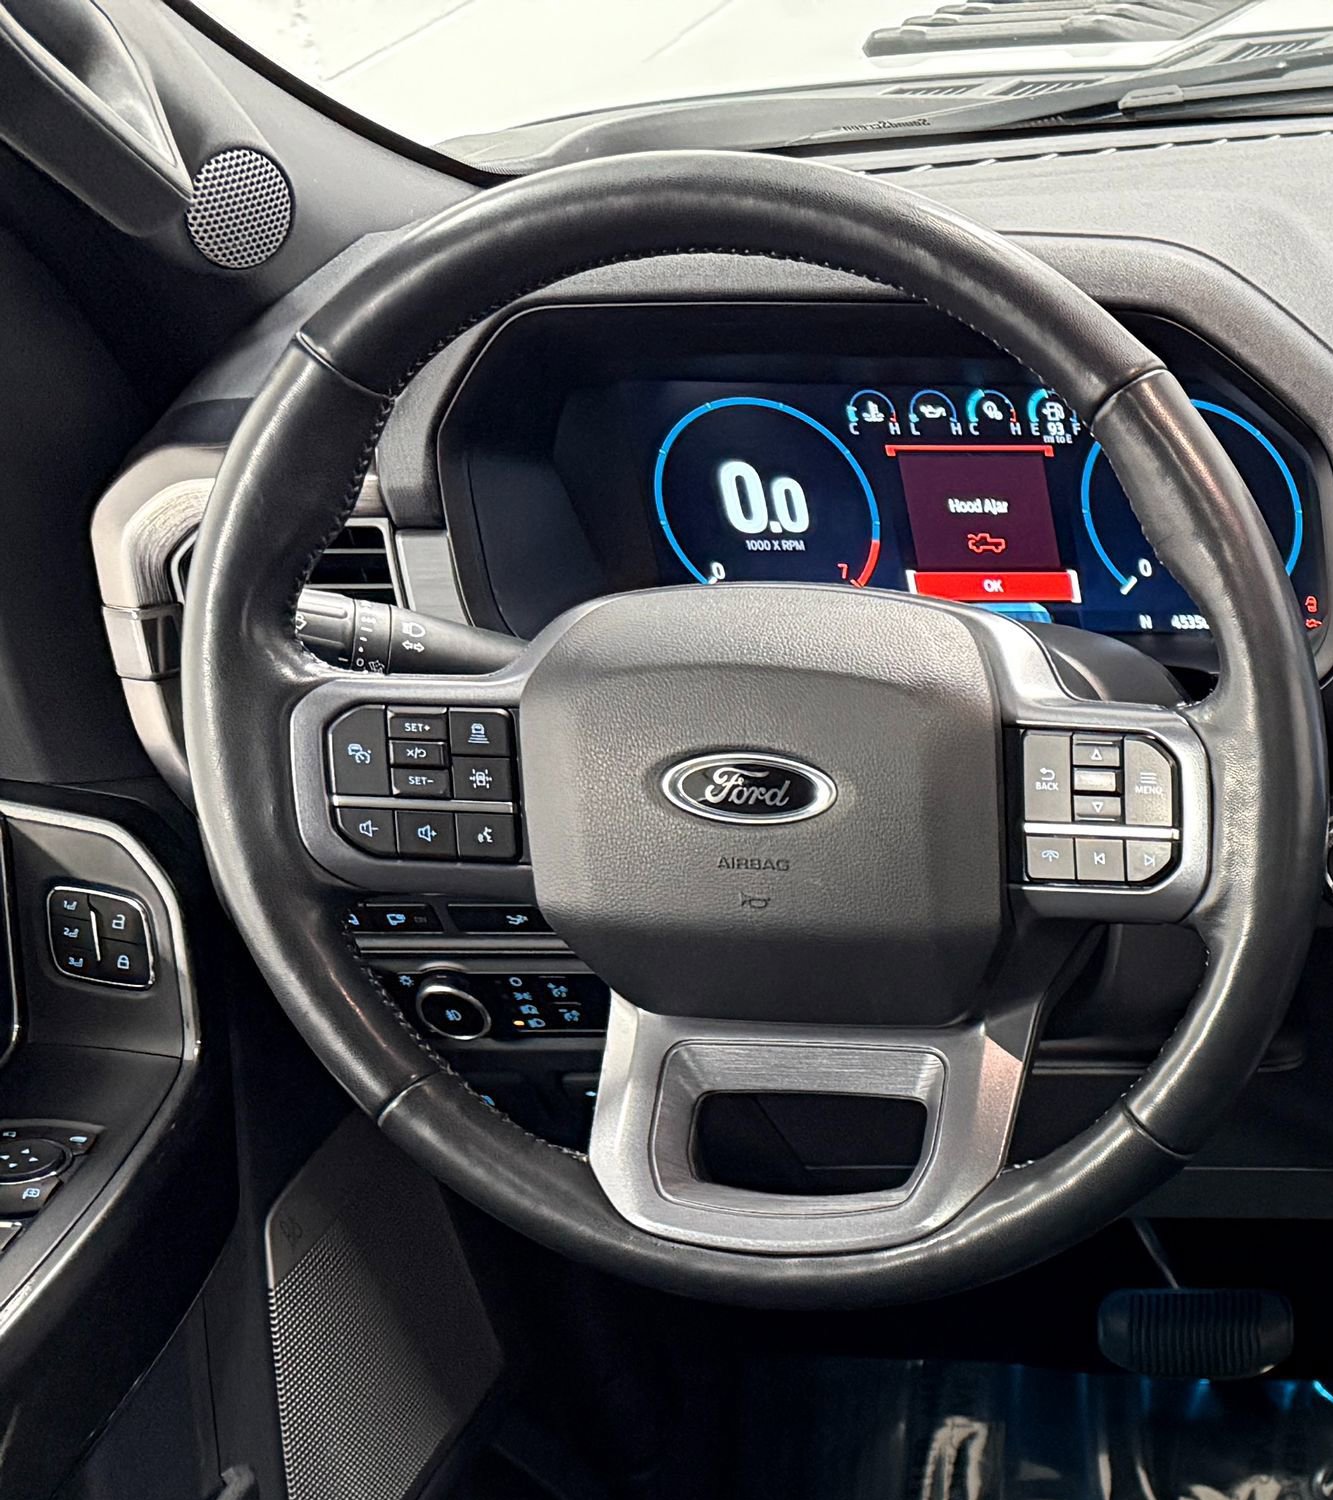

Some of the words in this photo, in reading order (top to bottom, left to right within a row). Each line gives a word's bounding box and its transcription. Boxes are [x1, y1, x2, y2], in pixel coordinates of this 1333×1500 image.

[889, 423, 900, 436] H
[911, 423, 920, 436] L
[951, 423, 962, 436] H
[969, 423, 979, 436] C
[1010, 423, 1021, 436] H
[1030, 423, 1040, 436] E
[1047, 423, 1064, 436] 93
[719, 460, 810, 535] 0.0
[948, 498, 982, 514] Hood
[983, 498, 1009, 516] Ajar
[745, 540, 771, 552] 1000
[781, 540, 806, 552] RPM
[711, 561, 726, 580] 0
[837, 563, 848, 578] 7
[1138, 558, 1152, 577] 0
[983, 579, 1004, 593] OK
[697, 765, 792, 807] Ford
[1035, 781, 1059, 791] BACK
[1135, 783, 1162, 795] MENU
[717, 857, 791, 872] AIRBAG
